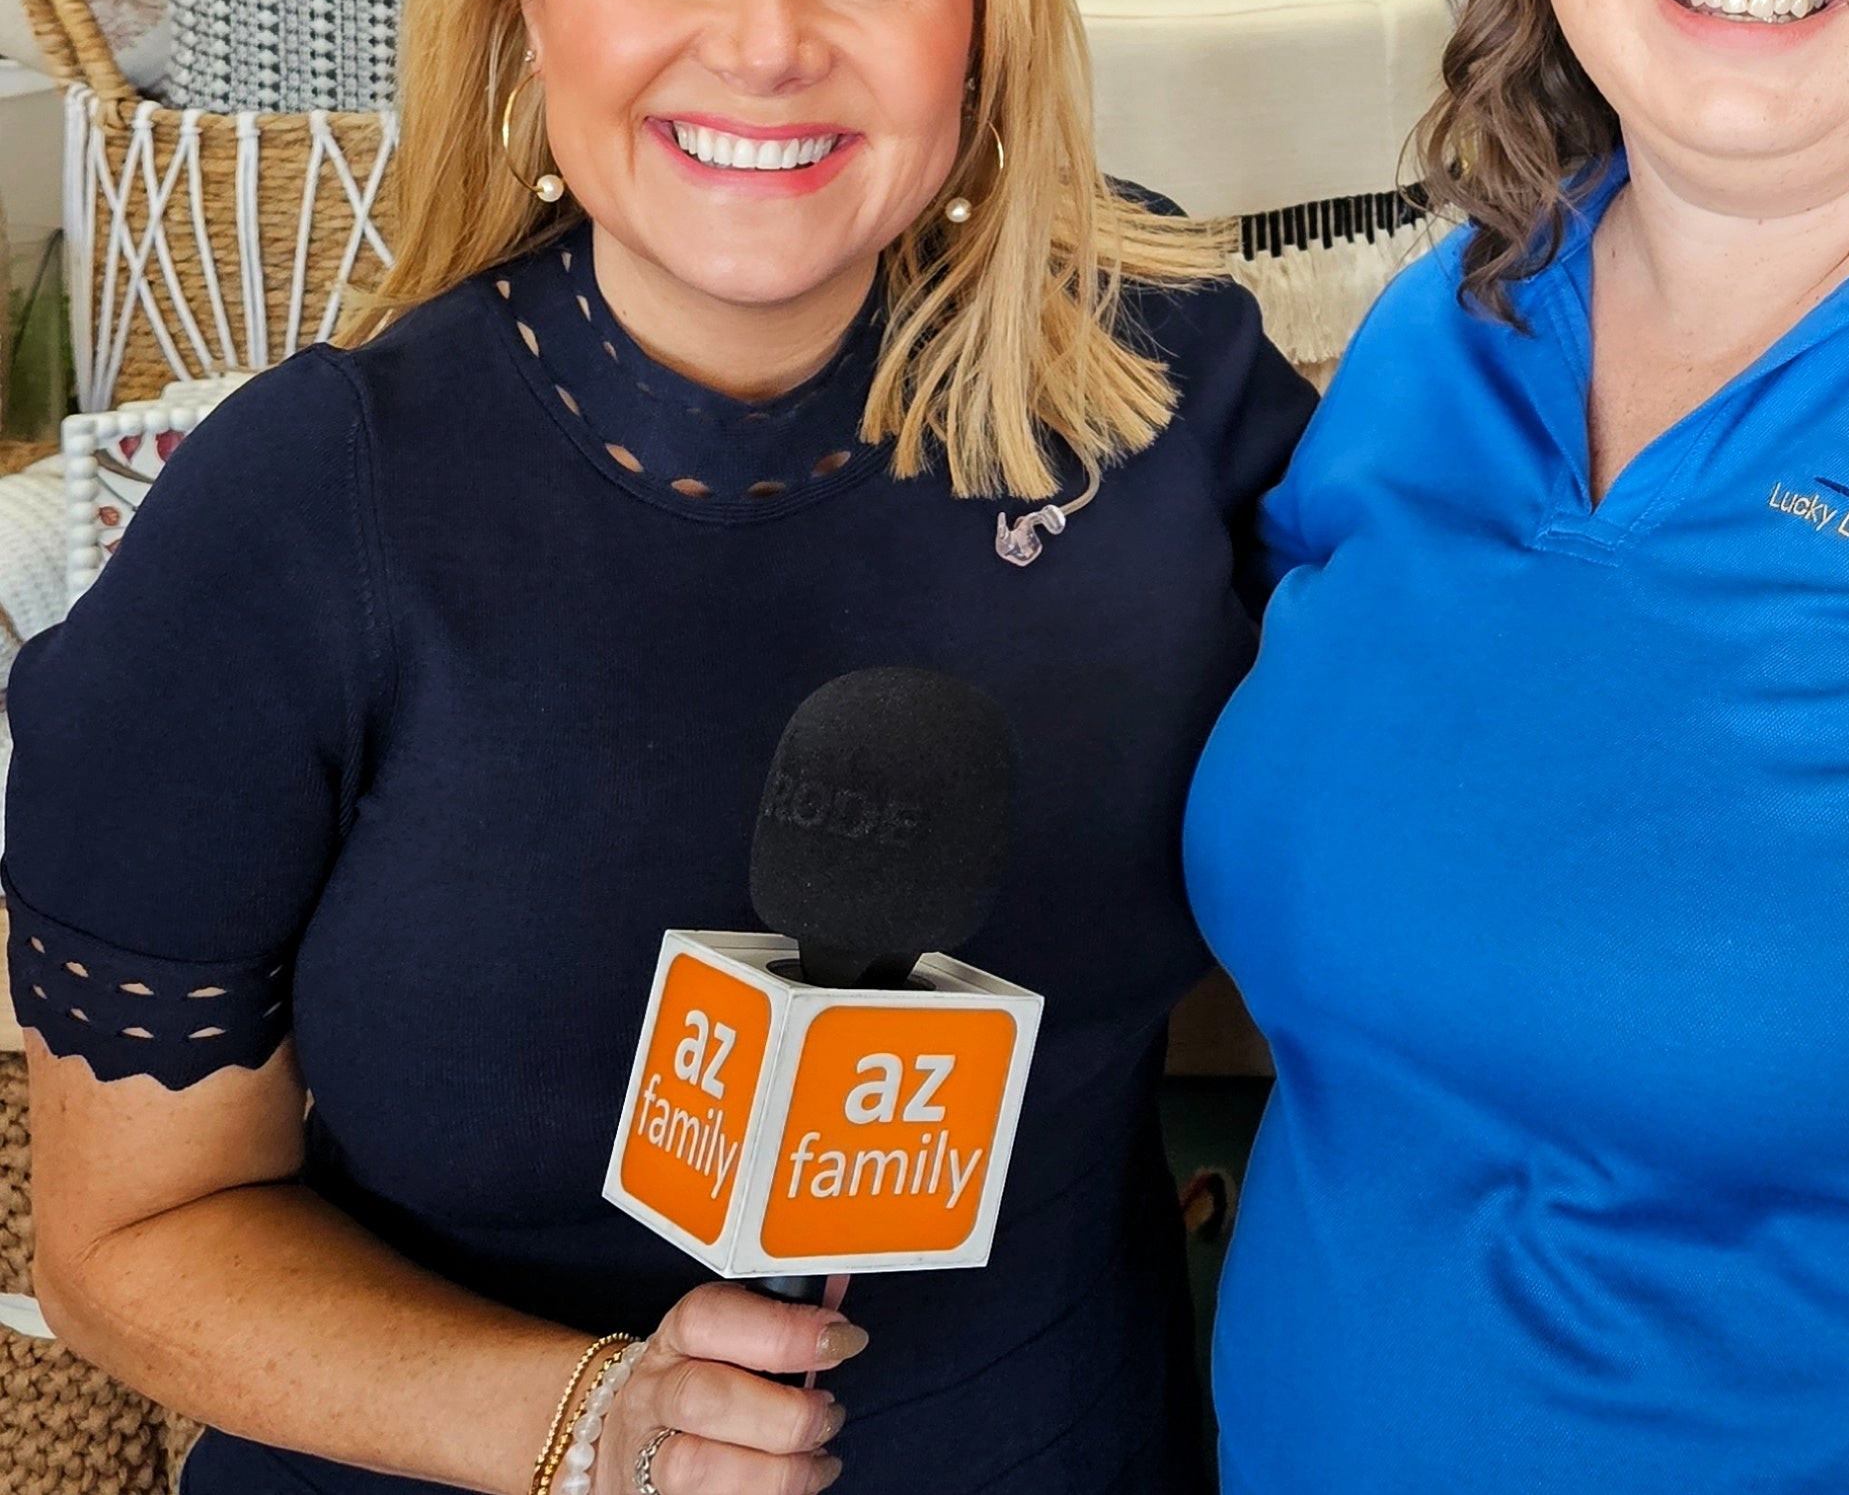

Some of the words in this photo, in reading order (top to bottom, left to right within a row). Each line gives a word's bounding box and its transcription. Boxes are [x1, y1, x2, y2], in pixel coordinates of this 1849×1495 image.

[1769, 482, 1837, 531] Lucky
[674, 1009, 736, 1100] az
[845, 1053, 956, 1124] az
[638, 1073, 738, 1199] family
[787, 1130, 983, 1209] family
